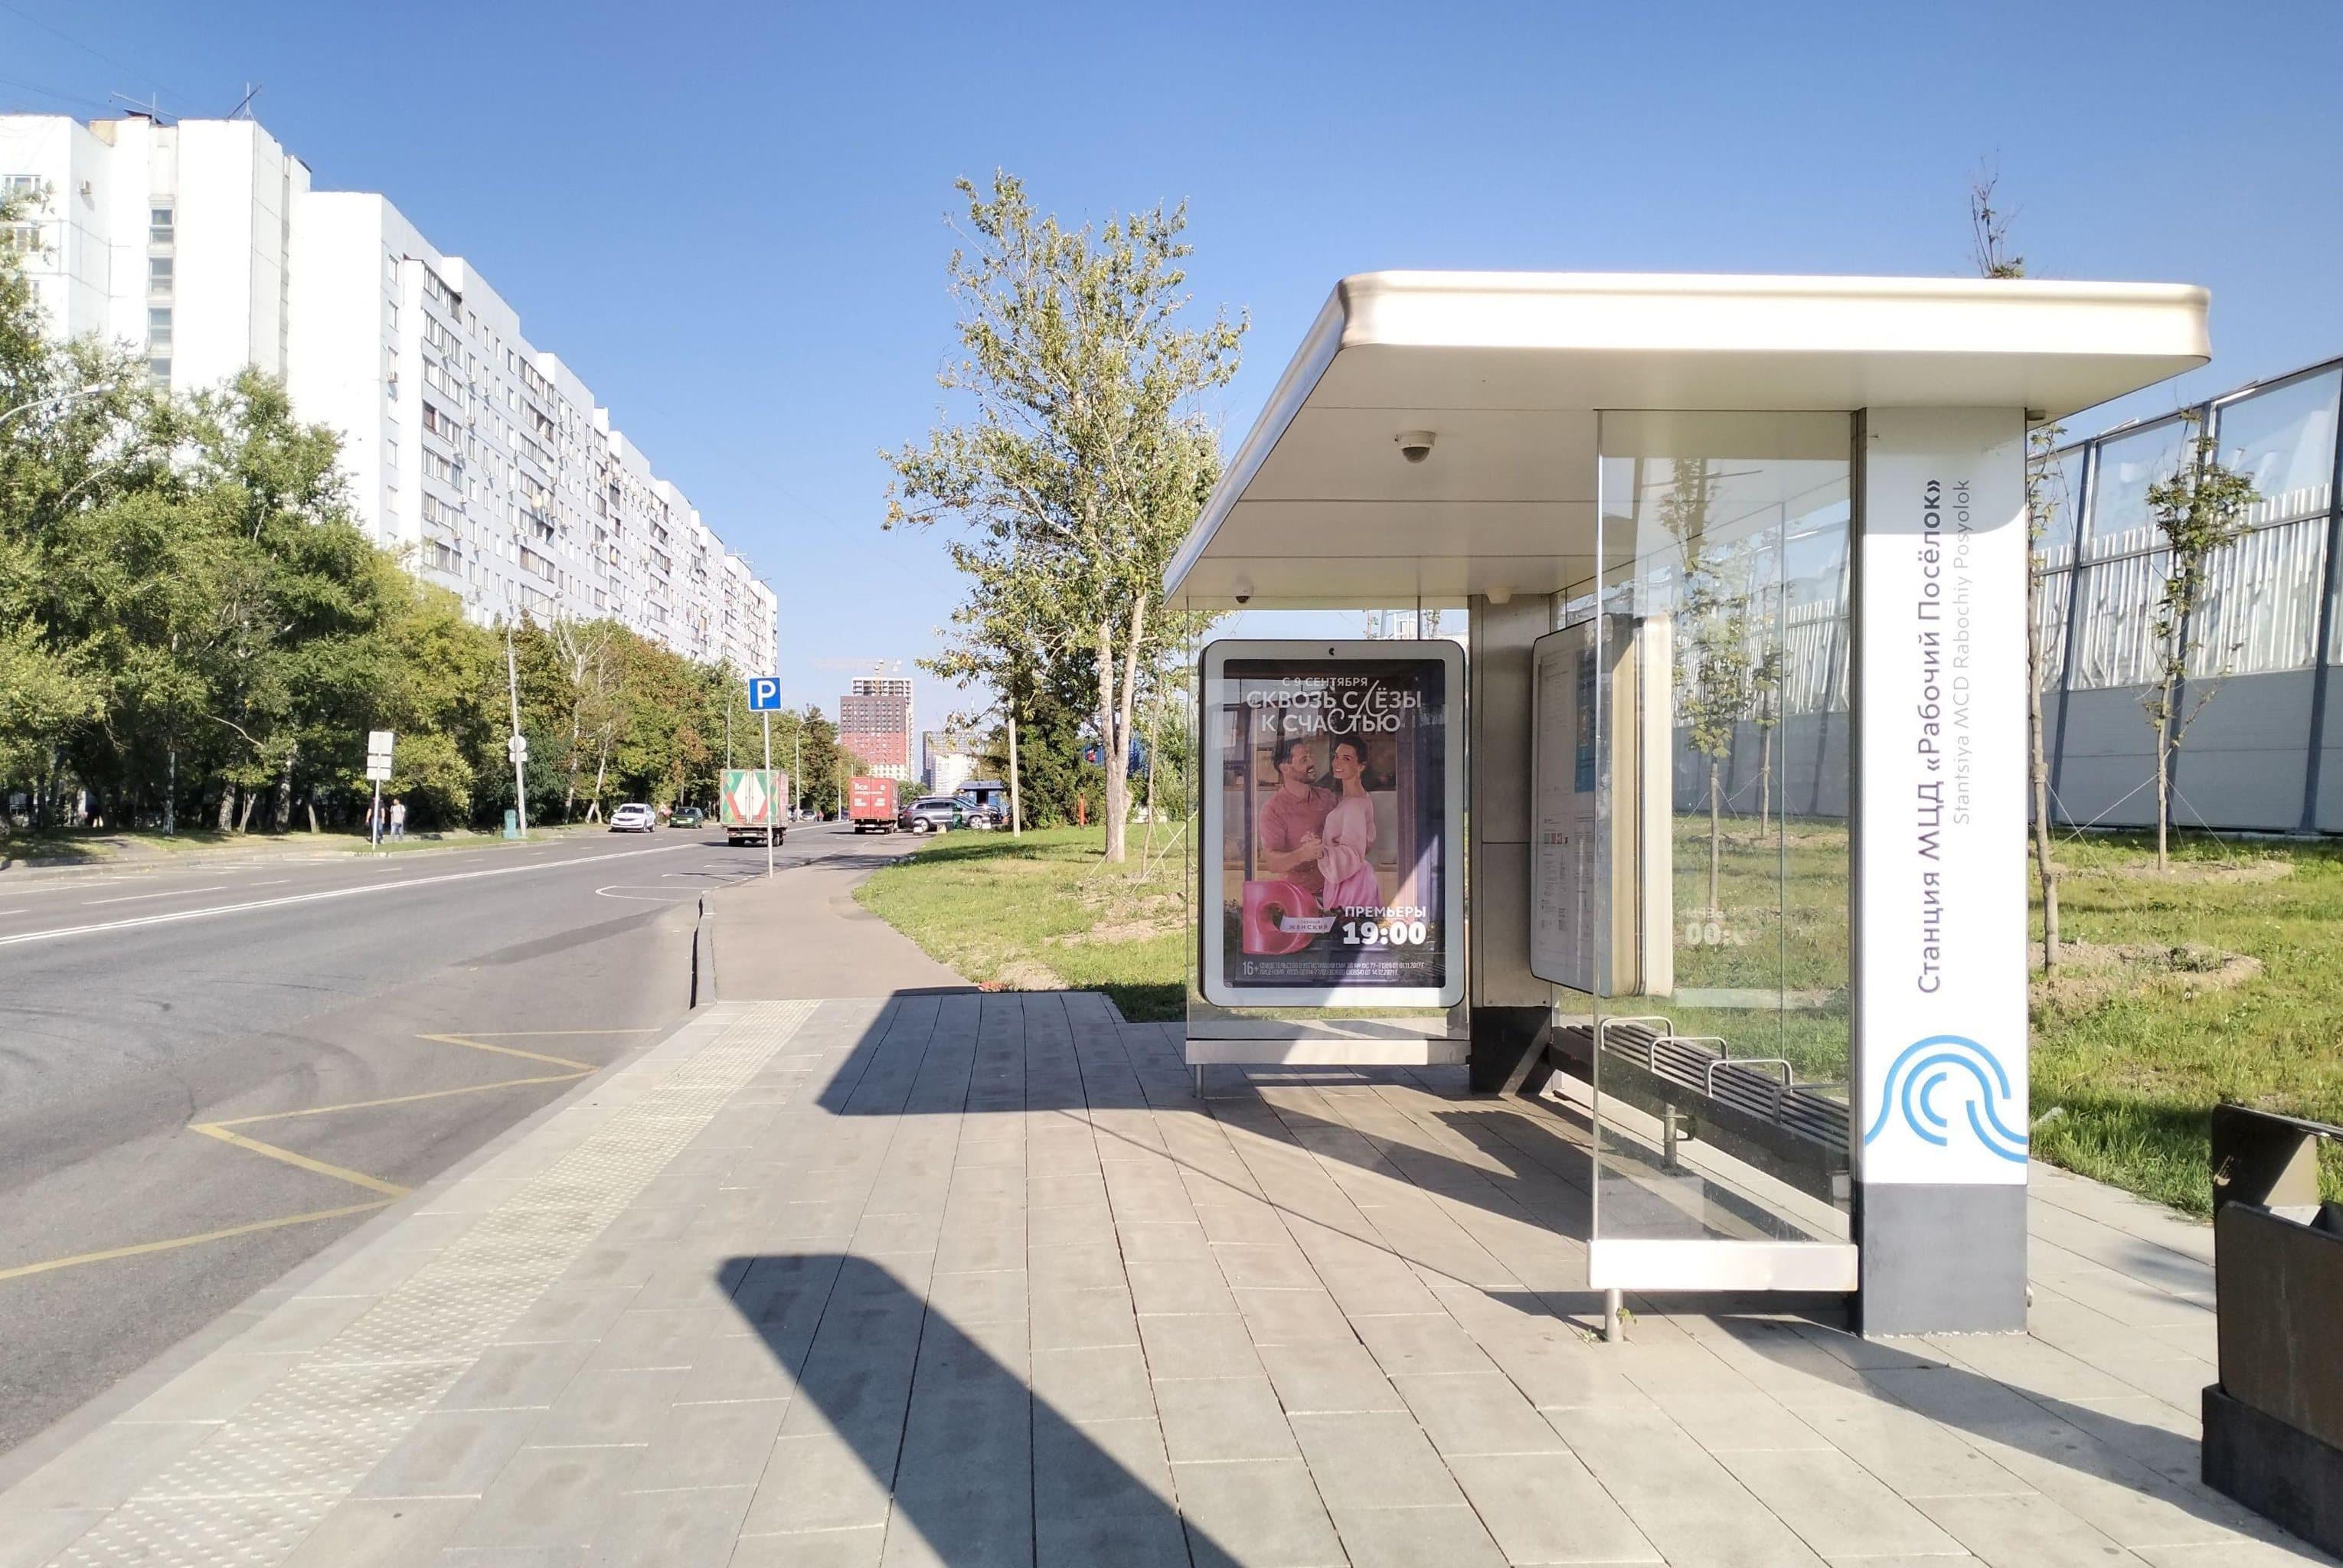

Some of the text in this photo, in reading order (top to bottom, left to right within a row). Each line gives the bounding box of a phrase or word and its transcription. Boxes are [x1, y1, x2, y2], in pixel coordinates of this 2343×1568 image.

[1952, 479, 1973, 825] Stantsiya MCD Rabochiy Posyolok
[757, 680, 776, 707] P
[1282, 677, 1368, 687] С 9 СЕНТЯБРЯ
[1246, 680, 1422, 716] СКВОЗЬ СЛЁЗЫ
[1261, 708, 1401, 735] К СЧАСТЬЮ
[1917, 478, 1945, 995] Станция МЦД «Рабочий Посёлок»
[1345, 906, 1427, 918] ПРЕМЬЕРЫ
[1343, 921, 1427, 946] 19:00
[1243, 961, 1259, 975] 16+
